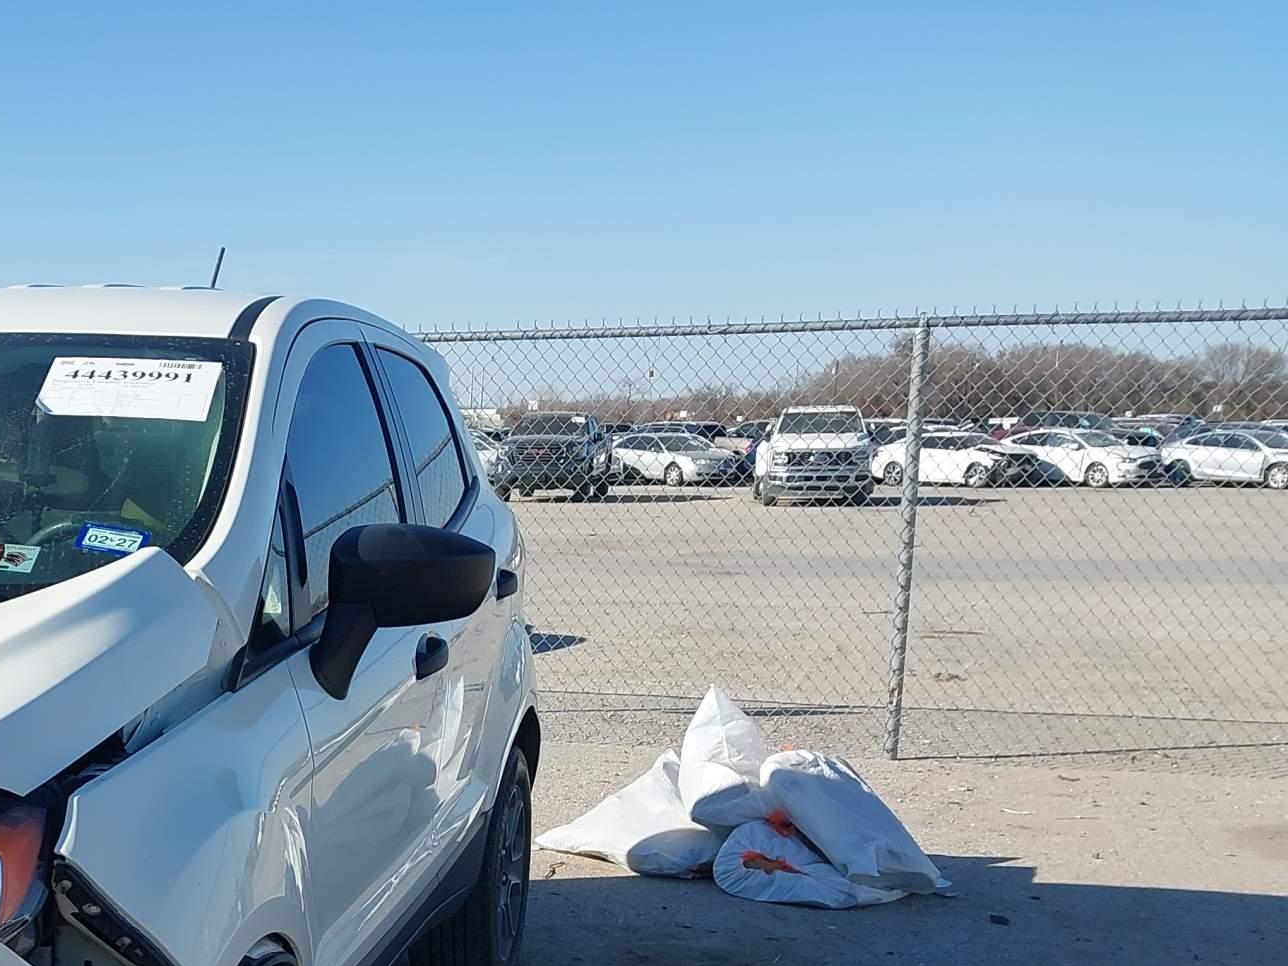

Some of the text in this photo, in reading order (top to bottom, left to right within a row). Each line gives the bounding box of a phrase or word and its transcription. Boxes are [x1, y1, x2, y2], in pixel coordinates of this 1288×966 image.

[64, 368, 193, 384] 44439991
[87, 533, 138, 549] 02 27
